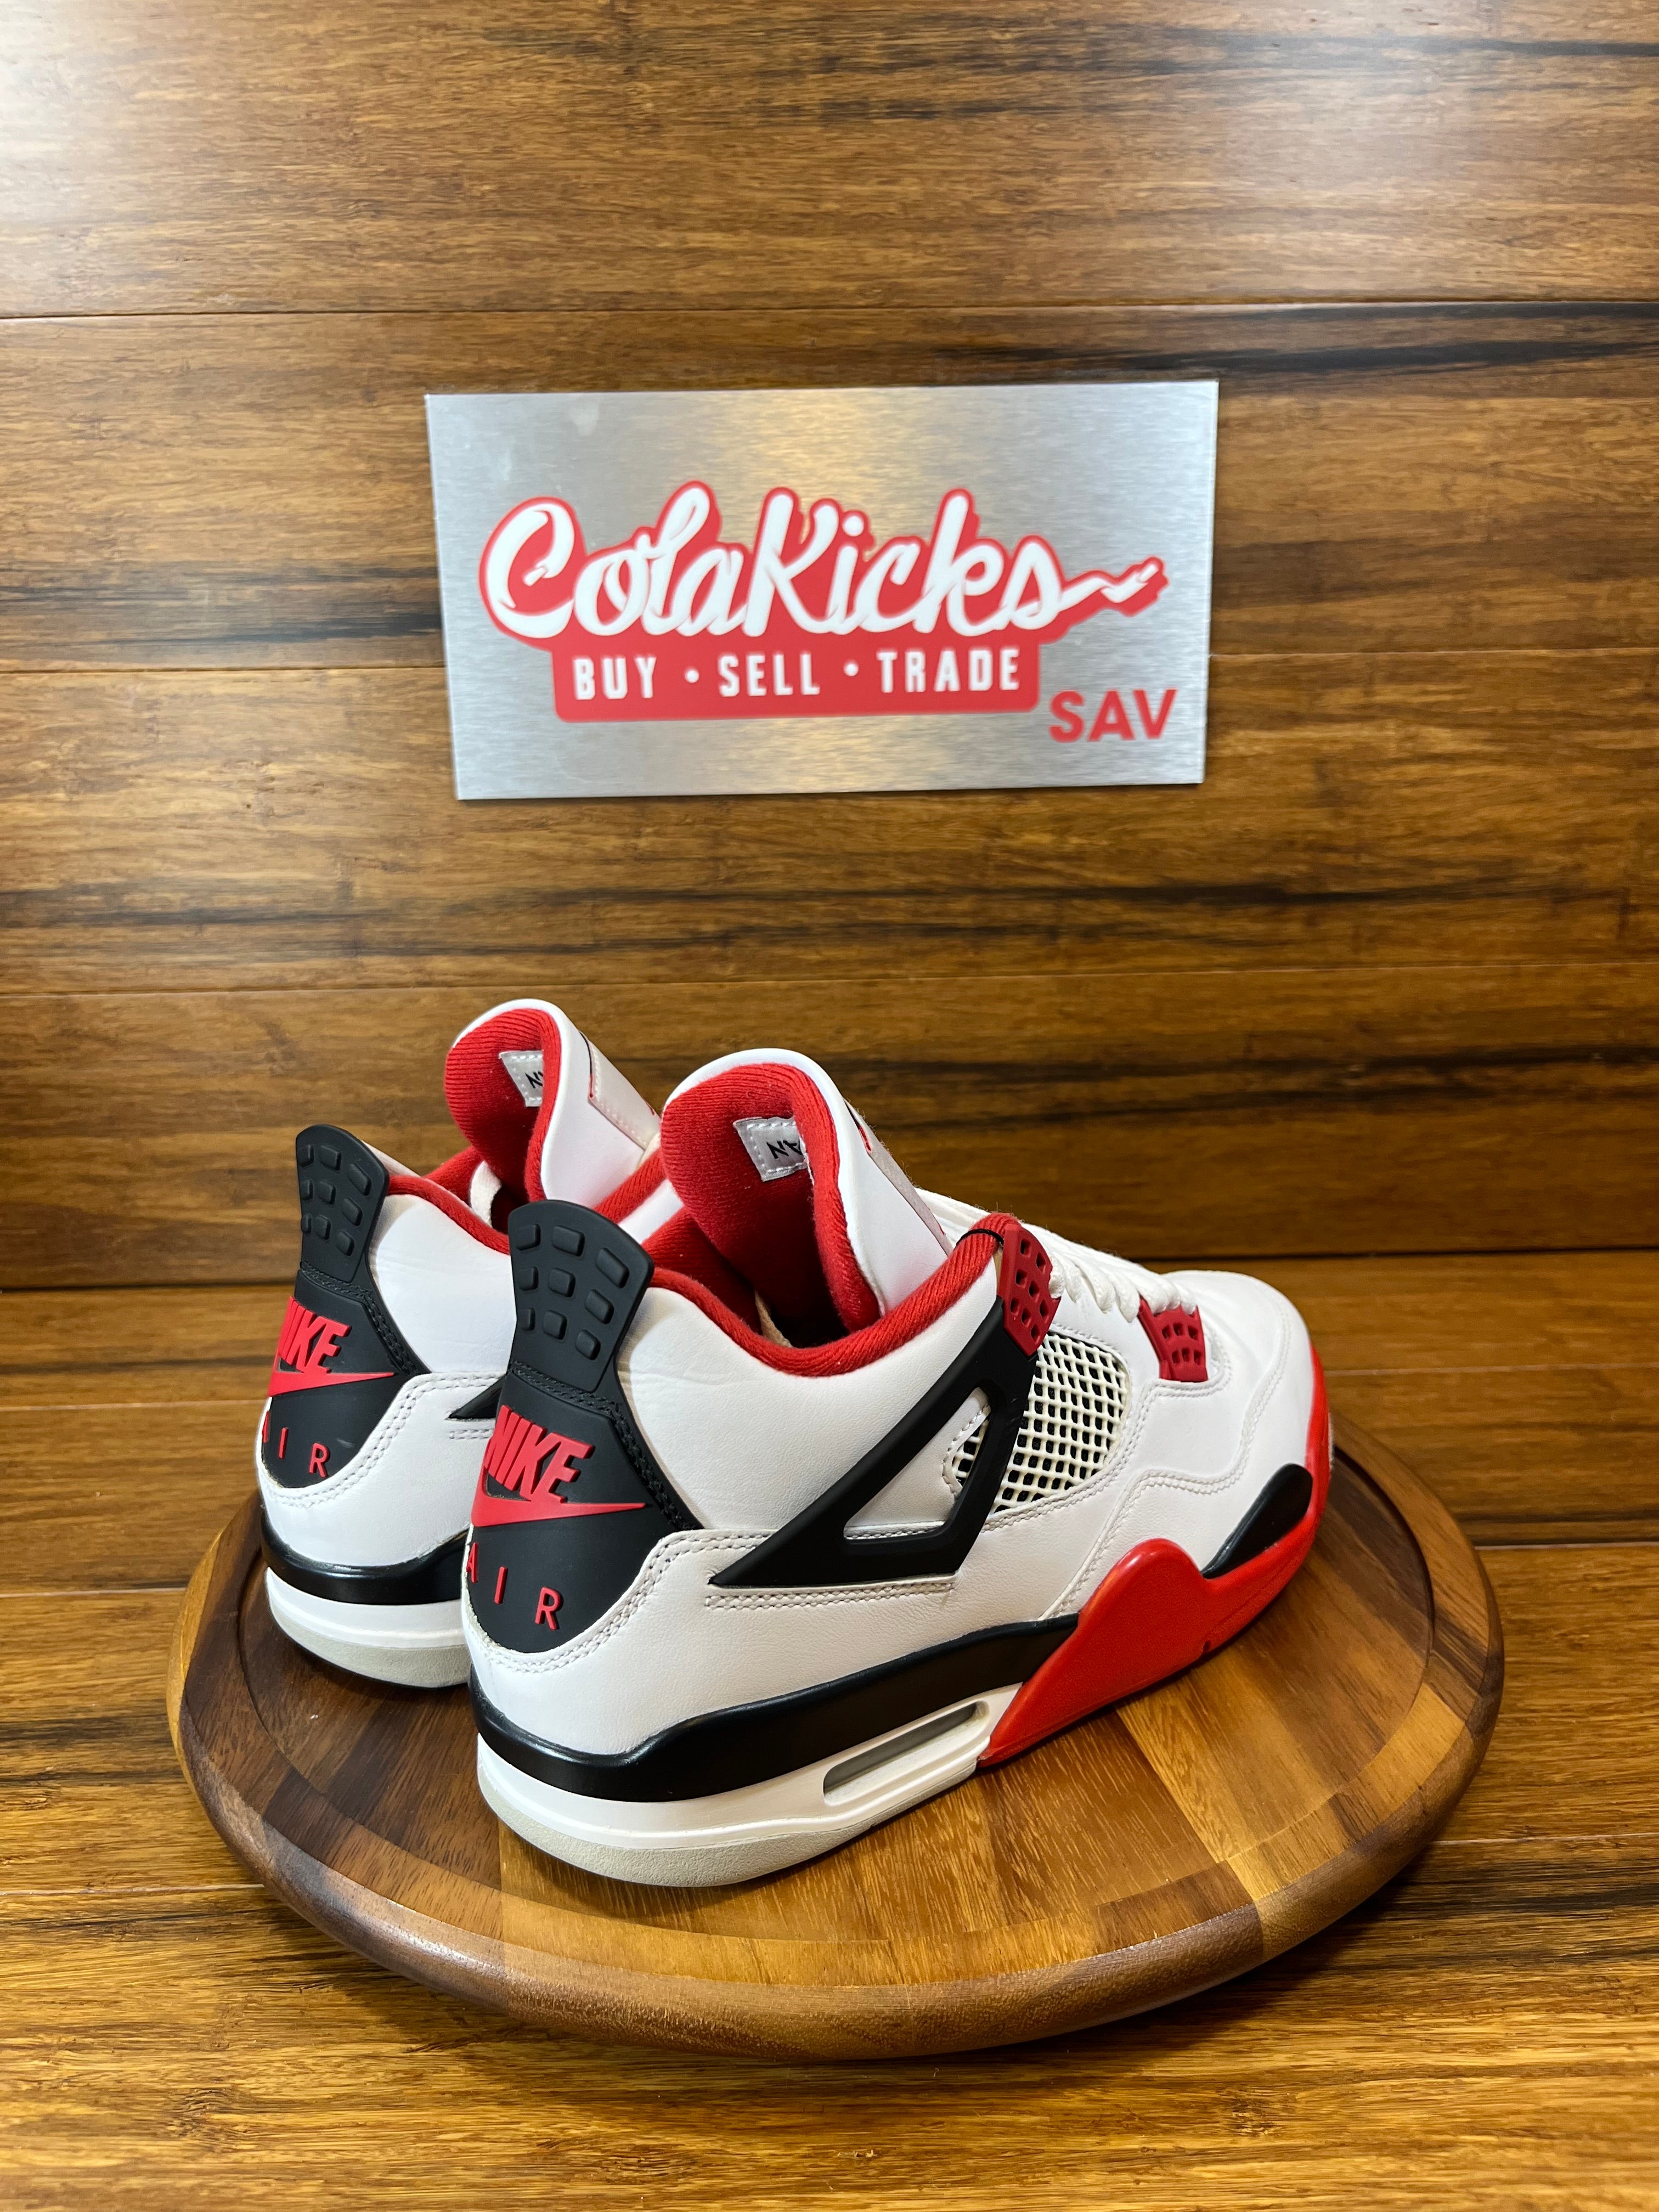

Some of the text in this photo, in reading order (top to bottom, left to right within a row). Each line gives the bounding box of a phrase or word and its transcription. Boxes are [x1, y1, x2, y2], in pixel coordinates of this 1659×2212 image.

[485, 487, 1159, 639] ColaKicks
[574, 648, 1019, 700] BUY SELL TRADE
[1049, 689, 1177, 743] SAV
[483, 1404, 595, 1503] NIKE
